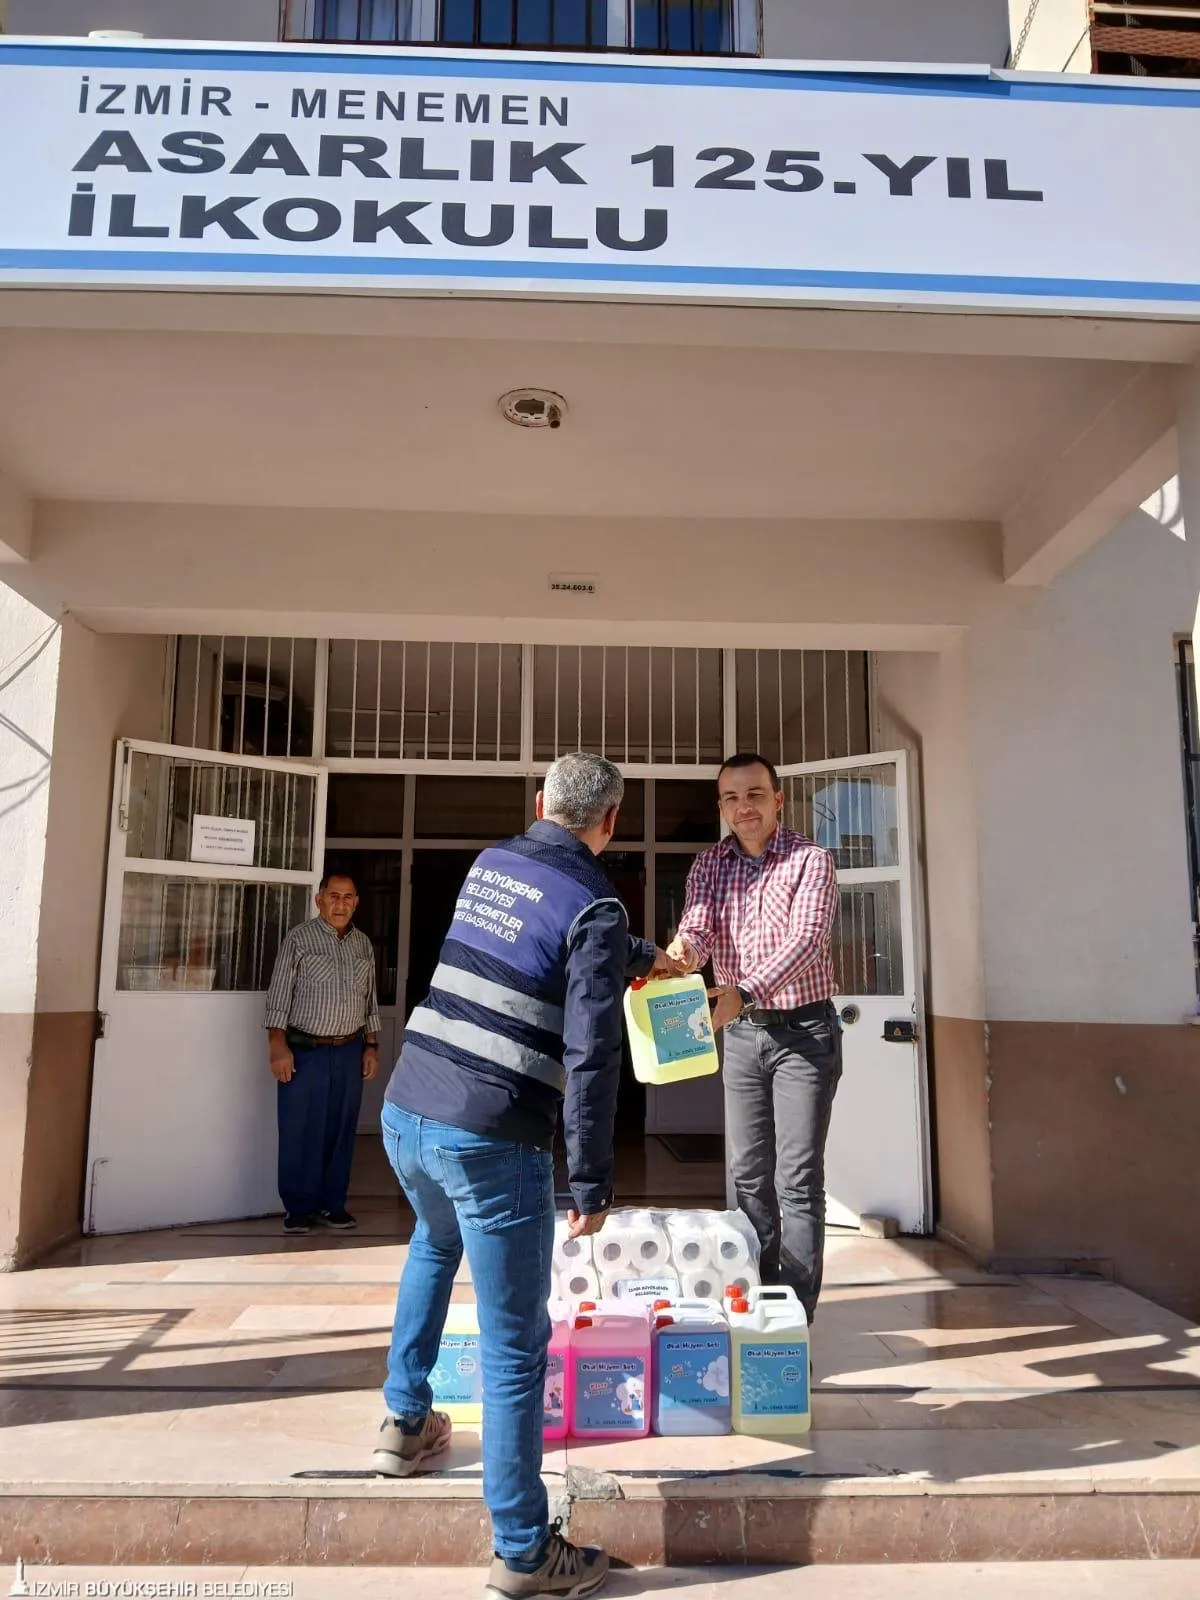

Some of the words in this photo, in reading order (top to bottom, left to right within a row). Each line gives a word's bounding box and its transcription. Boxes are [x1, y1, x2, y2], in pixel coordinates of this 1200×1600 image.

[78, 75, 233, 117] İZMİR
[290, 88, 570, 127] MENEMEN
[71, 129, 588, 185] ASARLIK
[630, 144, 1043, 202] 125.YIL
[67, 182, 669, 252] İLKOKULU
[466, 882, 517, 908] BELEDİYESİ
[481, 870, 544, 904] BÜYÜKŞEHİR
[464, 912, 518, 944] BAŞKANLIĞI
[472, 902, 524, 932] HİZMETLER
